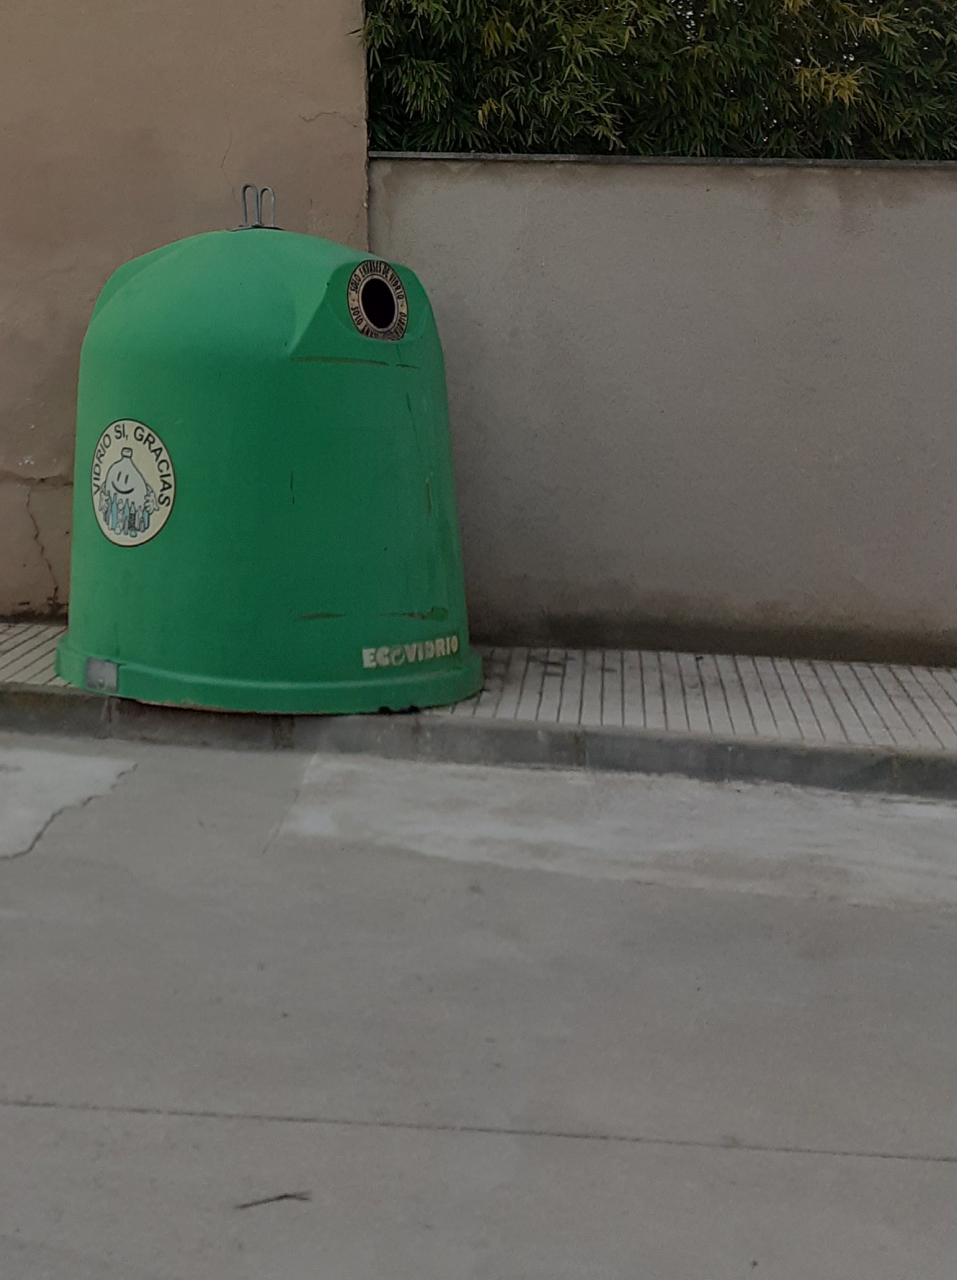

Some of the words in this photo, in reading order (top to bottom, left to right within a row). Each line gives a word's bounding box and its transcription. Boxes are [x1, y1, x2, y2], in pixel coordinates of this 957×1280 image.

[92, 433, 112, 495] VIDRIO
[133, 426, 173, 508] GRACIAS
[362, 635, 459, 669] ECOVIDRIO
